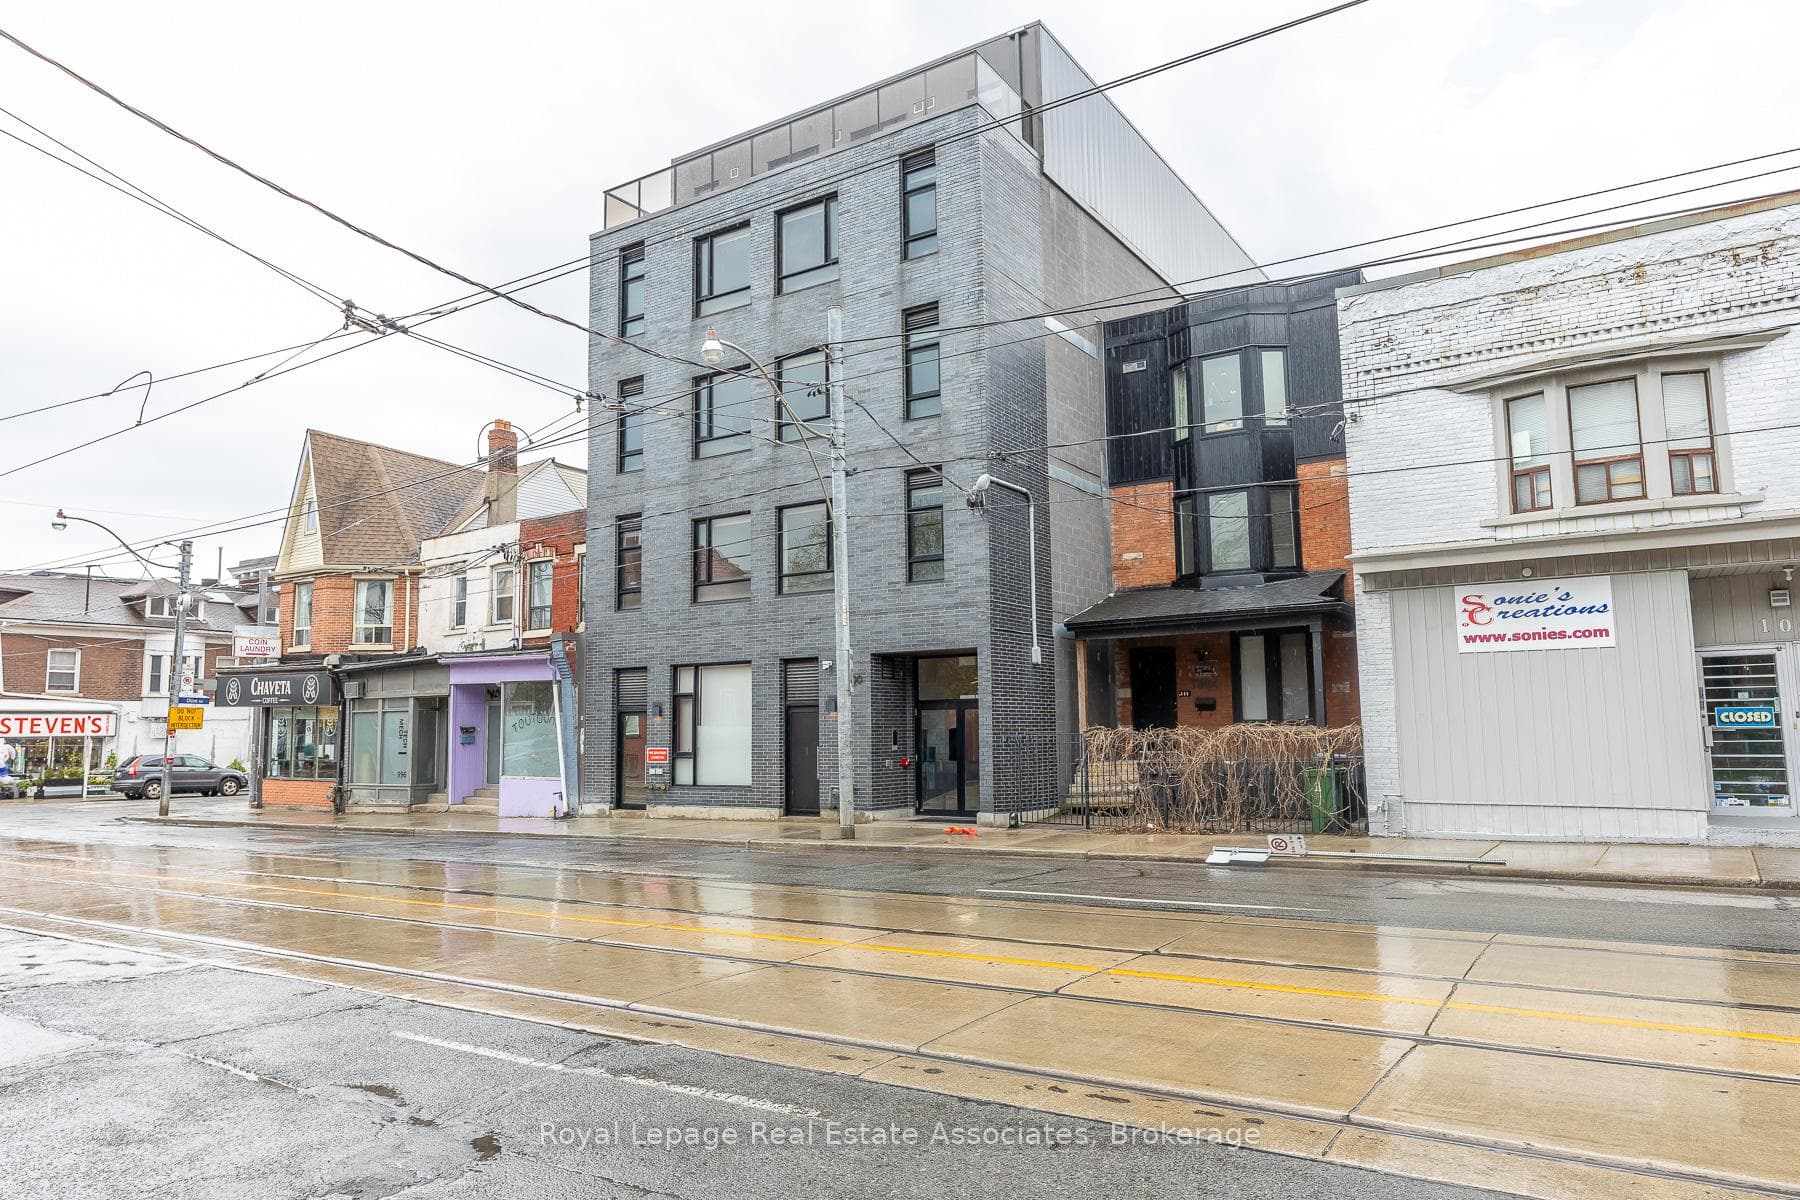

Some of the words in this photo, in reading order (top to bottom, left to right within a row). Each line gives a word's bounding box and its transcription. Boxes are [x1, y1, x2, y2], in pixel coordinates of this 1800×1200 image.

[1462, 587, 1574, 612] Sonie's
[1467, 602, 1610, 625] Creations
[248, 638, 268, 646] COIN
[1463, 627, 1610, 643] www.sonies.com
[240, 645, 276, 653] LAUNDRY
[250, 677, 292, 696] CHAVETA
[0, 715, 102, 735] STEVEN'S
[1720, 711, 1772, 723] CLOSED
